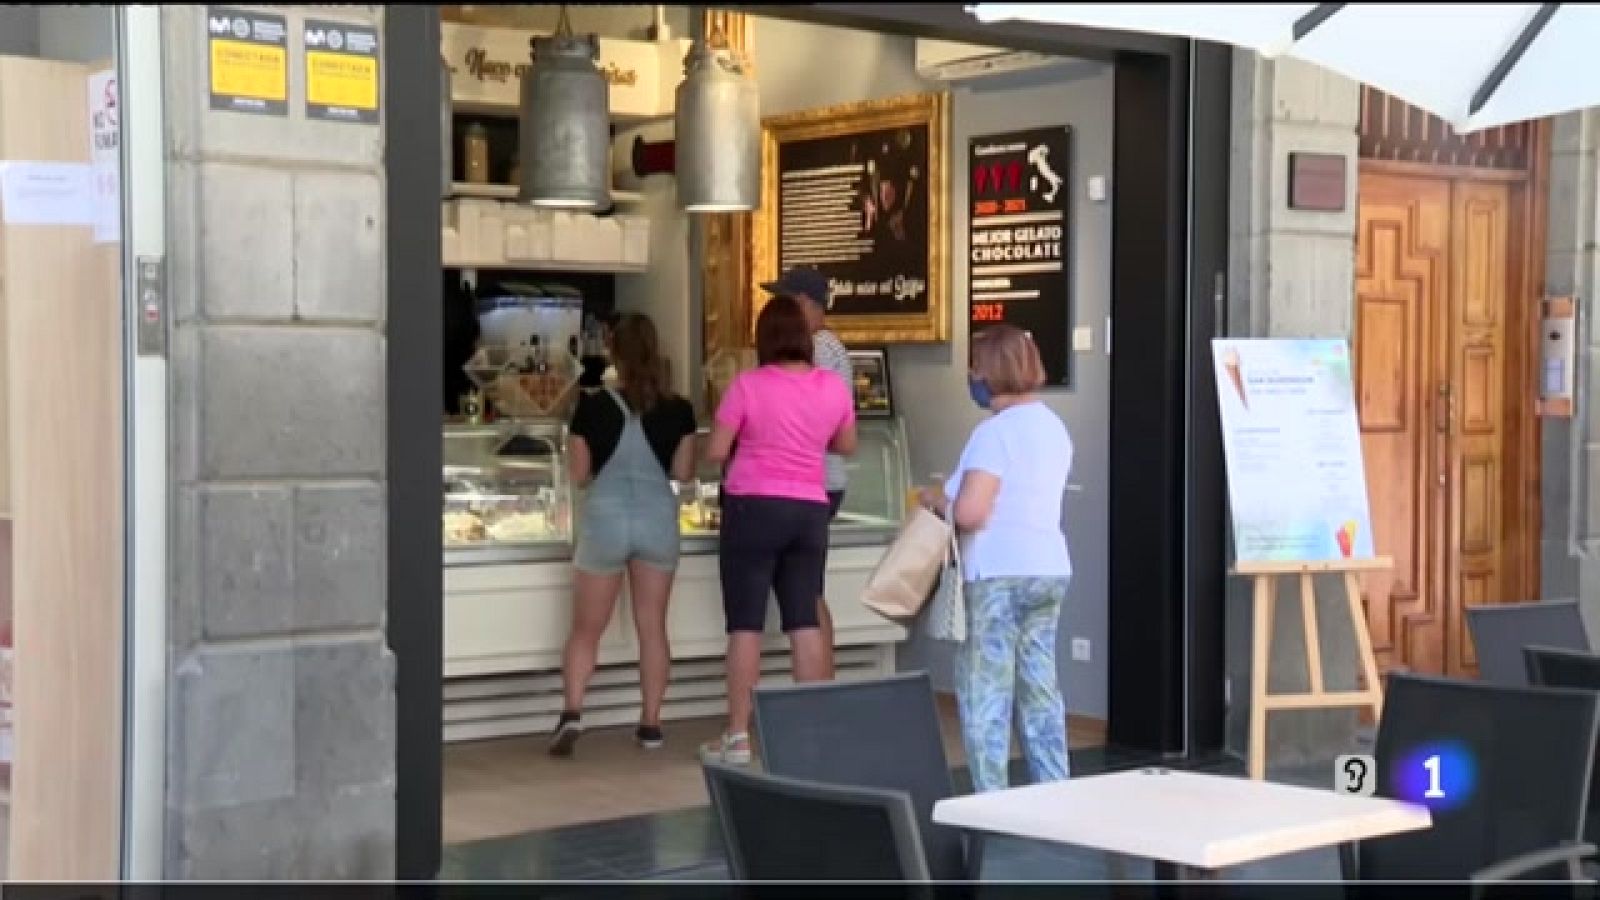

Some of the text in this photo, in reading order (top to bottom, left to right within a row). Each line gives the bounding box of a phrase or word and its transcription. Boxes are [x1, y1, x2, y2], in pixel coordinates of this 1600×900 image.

[972, 225, 1063, 244] MEJOR GELATO
[972, 242, 1063, 262] CHOCOLATE
[972, 303, 1004, 322] 2012
